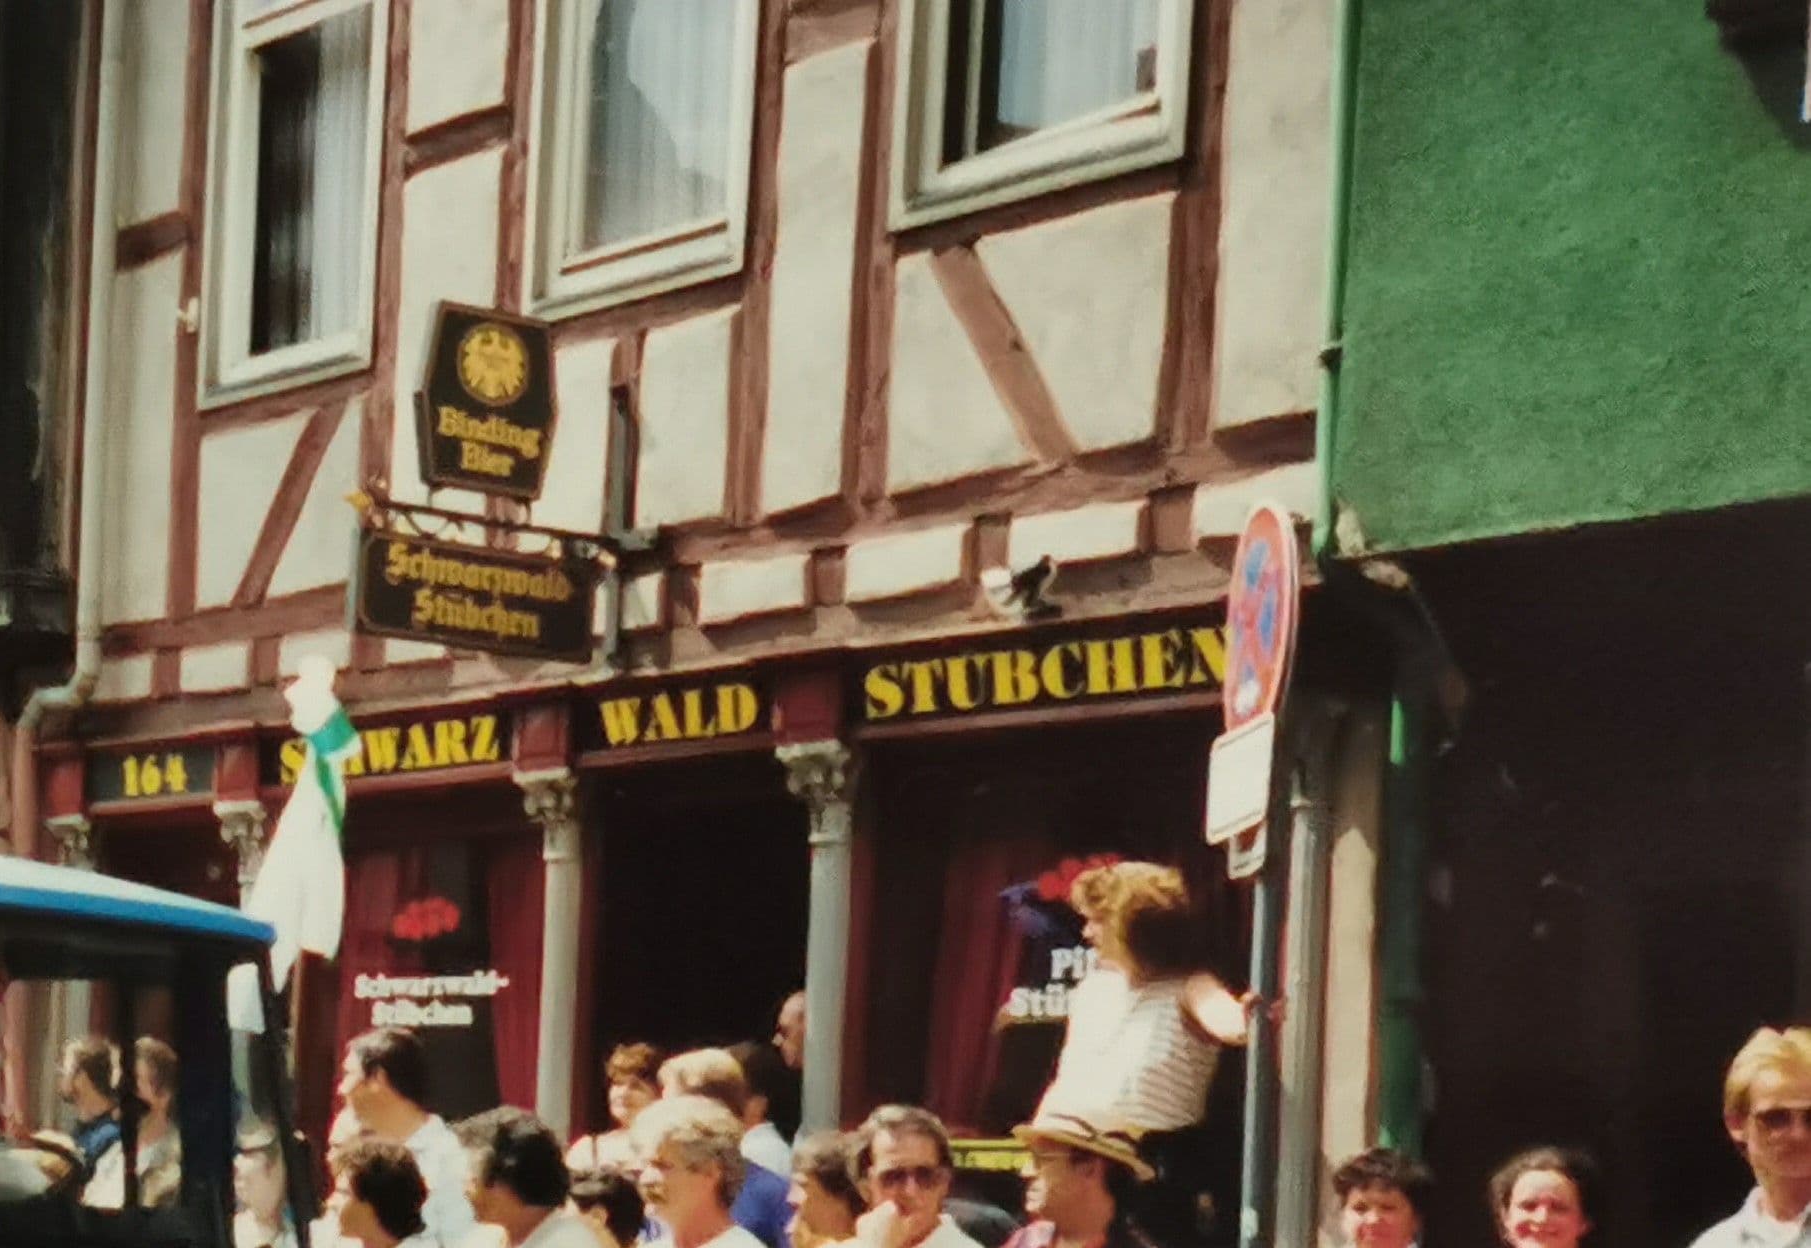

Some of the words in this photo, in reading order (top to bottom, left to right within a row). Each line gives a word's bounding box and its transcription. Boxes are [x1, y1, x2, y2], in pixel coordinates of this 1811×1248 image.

[438, 406, 541, 458] Binding
[461, 440, 515, 477] Bier
[599, 682, 760, 747] WALD
[122, 753, 187, 797] 164
